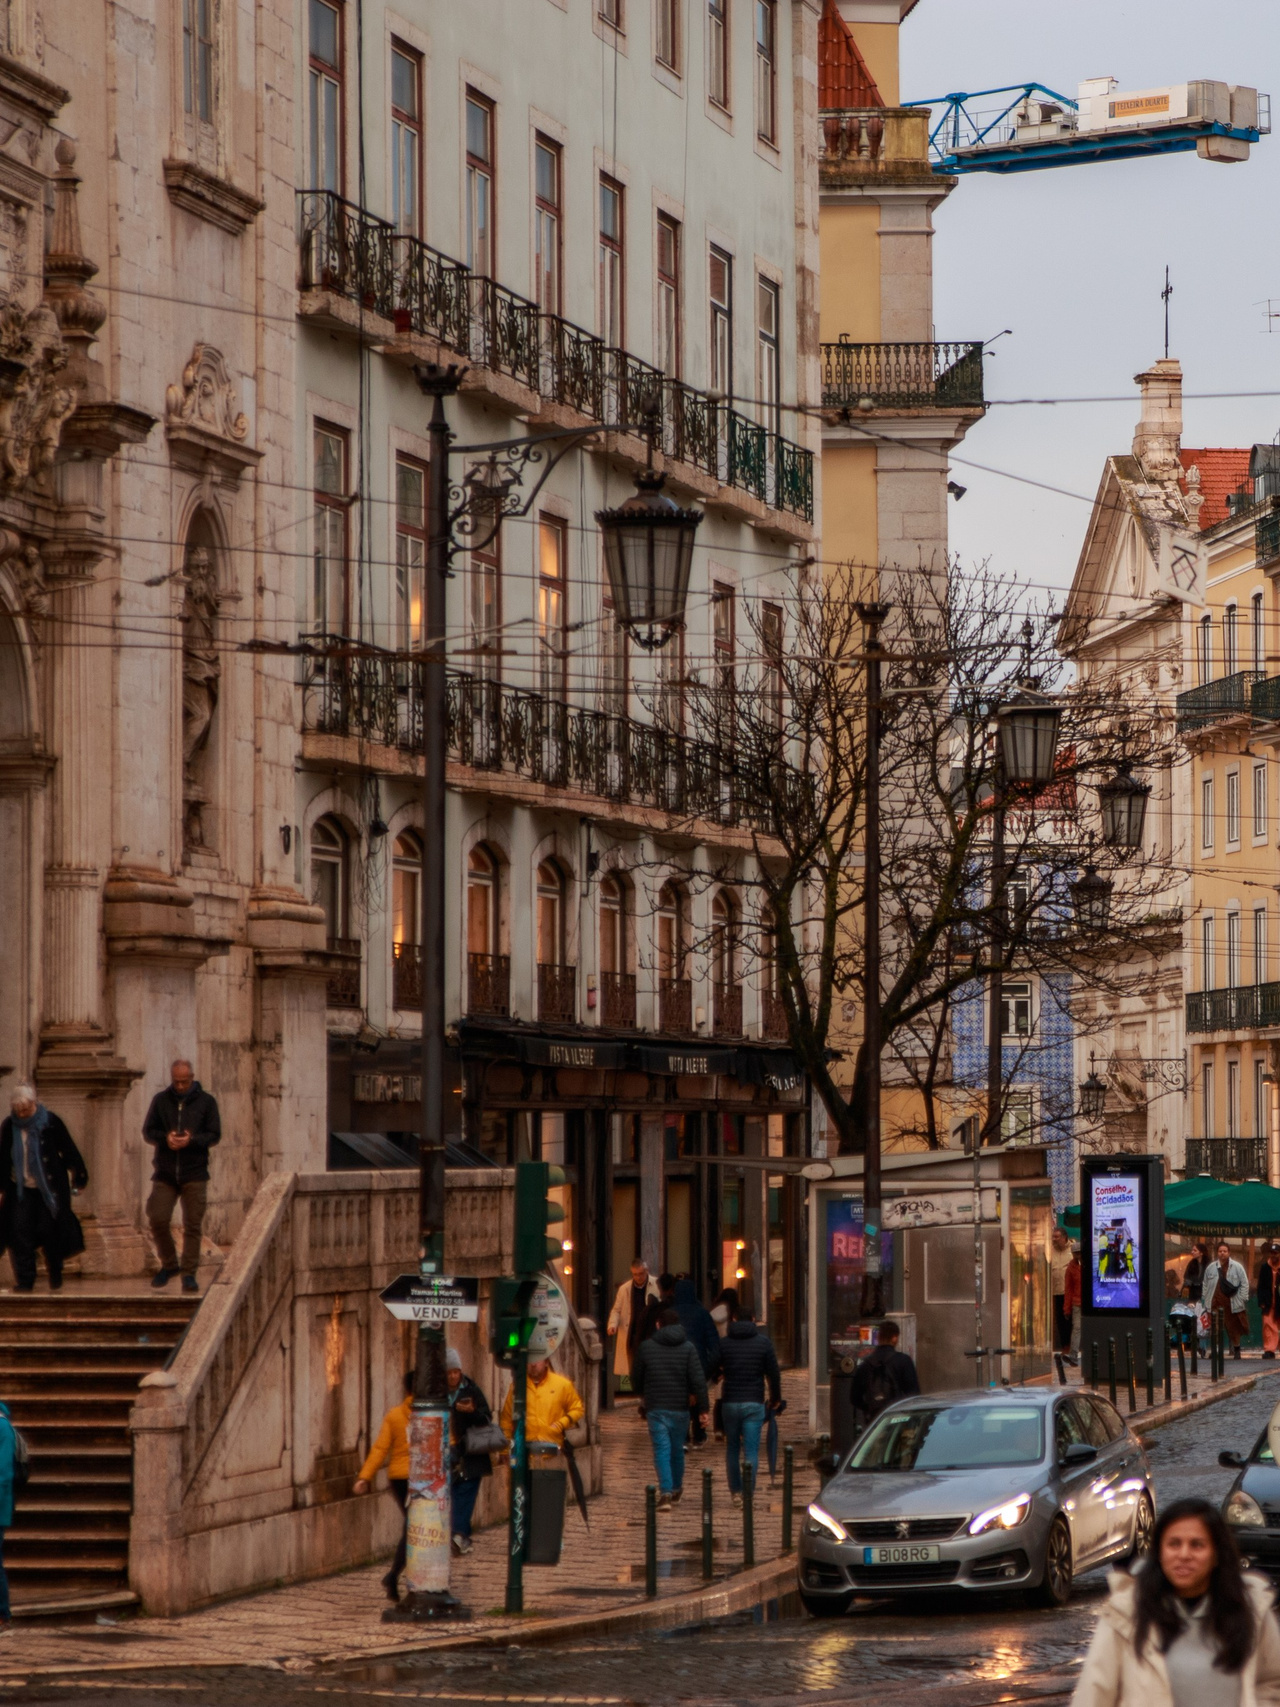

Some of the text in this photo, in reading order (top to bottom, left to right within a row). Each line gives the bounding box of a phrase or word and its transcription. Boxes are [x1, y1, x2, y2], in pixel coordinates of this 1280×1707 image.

[1116, 100, 1144, 111] TEIXEIRA
[1145, 96, 1169, 107] DUARTE
[1095, 1185, 1127, 1196] Conselho
[1101, 1194, 1134, 1205] Cidadãos
[1234, 1223, 1248, 1235] do
[412, 1306, 460, 1320] VENDE
